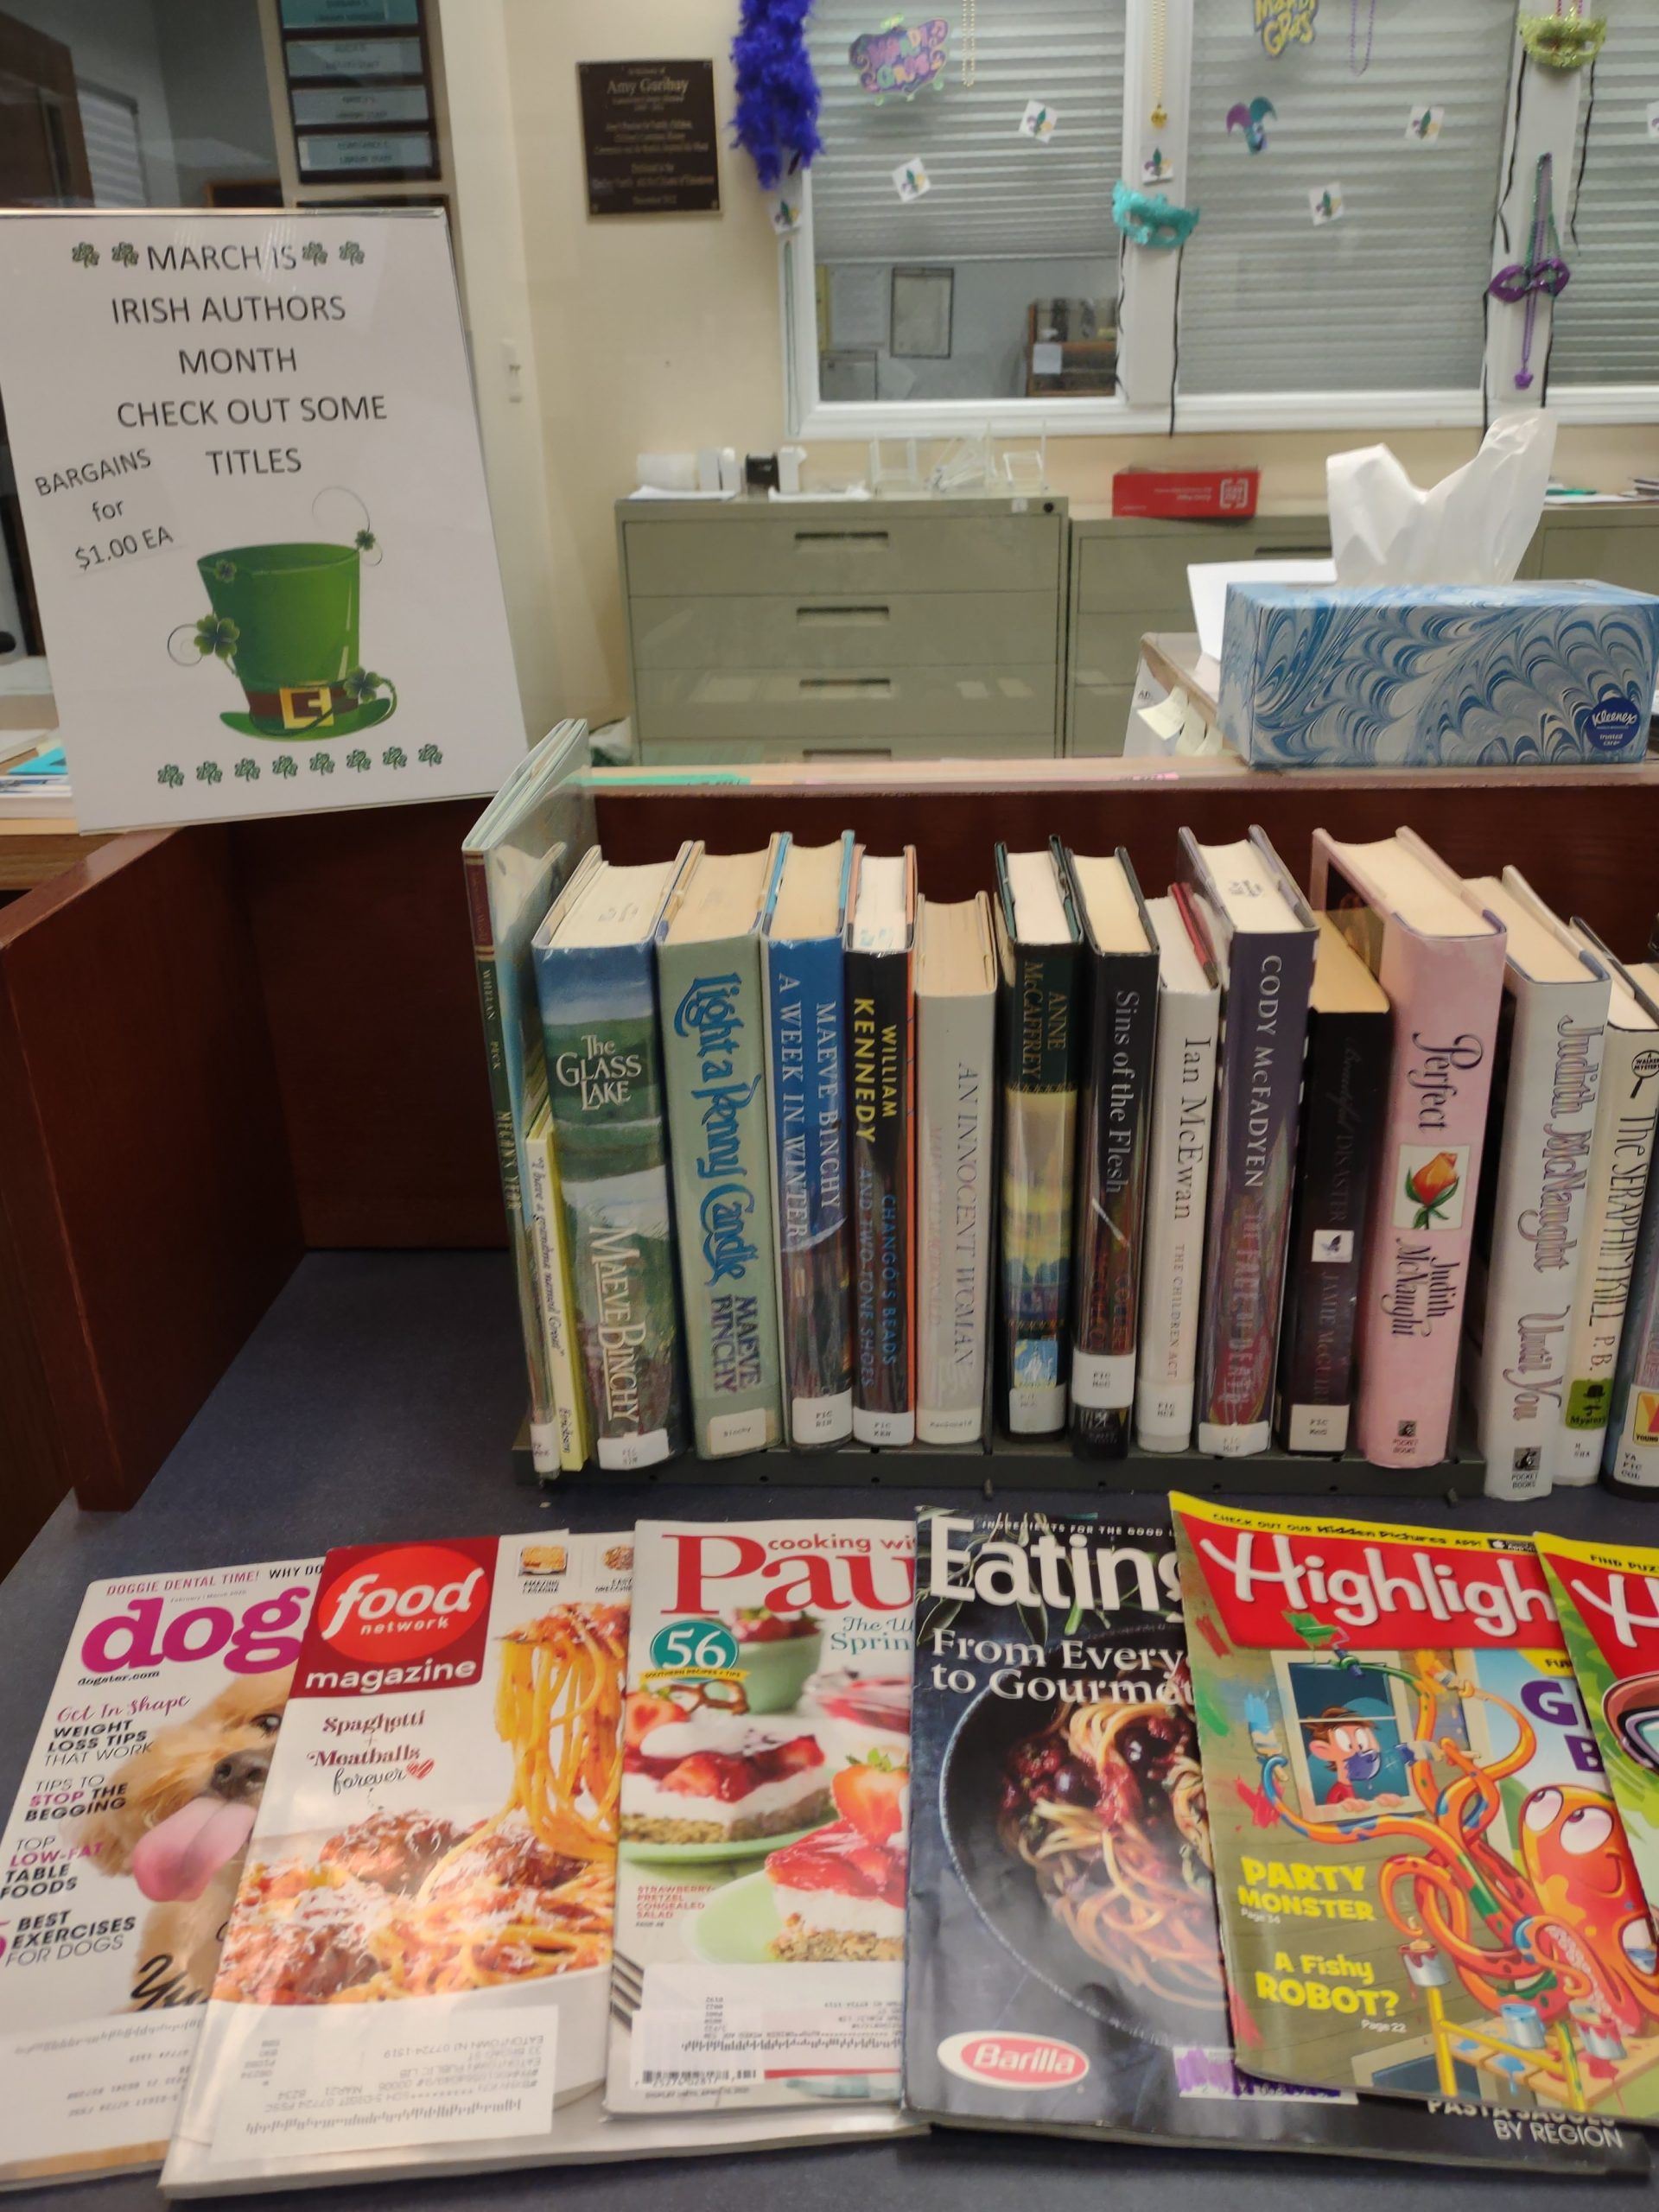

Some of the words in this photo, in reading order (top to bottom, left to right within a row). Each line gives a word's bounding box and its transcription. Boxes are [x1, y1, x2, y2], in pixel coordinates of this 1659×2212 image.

[147, 245, 262, 271] MARCH
[273, 245, 297, 270] IS
[111, 297, 190, 324] IRISH
[201, 296, 346, 323] AUTHORS
[178, 347, 297, 374] MONTH
[117, 400, 218, 428] CHECK
[226, 397, 290, 425] OUT
[300, 395, 388, 423] SOME
[35, 448, 151, 496] BARGAINS
[206, 448, 302, 475] TITLES
[92, 500, 124, 522] for
[74, 534, 137, 571] $1.00
[141, 525, 174, 550] EA
[1592, 709, 1637, 727] Kleenex
[779, 972, 801, 994] A
[1255, 955, 1282, 1035] CODY
[674, 972, 744, 1058] Light
[1022, 961, 1044, 1080] McCAFFREY
[1046, 991, 1068, 1051] ANNE
[1114, 990, 1139, 1046] Sins
[581, 1034, 616, 1057] The
[779, 1001, 804, 1083] WEEK
[816, 1000, 839, 1099] MAEVE
[556, 1052, 642, 1087] GLASS
[702, 1059, 733, 1082] a
[854, 998, 875, 1143] KENNEDY
[880, 1024, 897, 1117] WILLIAM
[1112, 1052, 1135, 1079] of
[1183, 1038, 1211, 1084] Ian
[1550, 1014, 1605, 1119] Judith
[581, 1079, 632, 1111] LAKE
[958, 1063, 978, 1106] AN
[1407, 1032, 1483, 1135] Perfect
[783, 1092, 804, 1123] IN
[1110, 1083, 1135, 1122] the
[691, 1073, 761, 1179] Penny
[1614, 1108, 1657, 1158] The
[818, 1109, 842, 1209] BINCHY
[1106, 1128, 1131, 1193] Flesh
[1175, 1095, 1207, 1220] McEwan
[783, 1133, 810, 1236] WINTER
[956, 1114, 977, 1252] INNOCENT
[1517, 1123, 1592, 1274] McNaught
[700, 1184, 759, 1287] Candle
[1174, 1244, 1185, 1271] THE
[589, 1226, 640, 1325] MAEVE
[1426, 1255, 1460, 1317] Judith
[954, 1266, 976, 1366] WOMAN
[1169, 1275, 1183, 1347] CHILDREN
[1588, 1277, 1630, 1327] KILL
[711, 1294, 737, 1394] BINCHY
[735, 1296, 760, 1386] MAEVE
[880, 1306, 897, 1366] BEADS
[1518, 1305, 1571, 1375] Until
[596, 1322, 647, 1423] BINCHY
[1167, 1351, 1178, 1377] ACT
[1503, 1368, 1563, 1421] You
[1070, 1524, 1093, 1535] FOR
[1098, 1526, 1122, 1535] THE
[1128, 1527, 1163, 1537] GOOD
[1213, 1513, 1252, 1527] CHECK
[1257, 1521, 1281, 1529] OUT
[768, 1533, 870, 1553] cooking
[1591, 1554, 1623, 1567] FIND
[106, 1583, 158, 1597] DOGGIE
[164, 1578, 216, 1592] DENTAL
[222, 1571, 259, 1584] TIME!
[270, 1567, 301, 1580] WHY
[321, 1567, 485, 1641] food
[360, 1615, 448, 1636] network
[842, 1616, 881, 1631] The
[663, 1628, 726, 1669] 56
[932, 1628, 1046, 1668] From
[1061, 1640, 1184, 1679] Every
[77, 1670, 160, 1686] dogster.com
[305, 1658, 477, 1694] magazine
[931, 1663, 976, 1693] to
[56, 1704, 95, 1724] Get
[100, 1700, 123, 1719] In
[130, 1694, 191, 1717] Shape
[322, 1709, 425, 1738] Spaghetti
[48, 1736, 99, 1753] LOSS
[105, 1731, 147, 1746] TIPS
[54, 1719, 133, 1738] WEIGHT
[44, 1751, 89, 1767] THAT
[96, 1741, 154, 1760] WORK
[306, 1744, 421, 1767] Meatballs
[29, 1790, 85, 1808] STOP
[91, 1783, 128, 1800] THE
[35, 1778, 73, 1792] TIPS
[80, 1774, 105, 1788] TO
[333, 1764, 408, 1796] forever
[24, 1797, 126, 1822] BEGGING
[9, 1841, 105, 1867] LOW-FAT
[16, 1835, 56, 1852] TOP
[0, 1876, 78, 1900] FOODS
[5, 1864, 70, 1883] TABLE
[1241, 1857, 1366, 1892] PARTY
[1237, 1885, 1376, 1922] MONSTER
[1241, 1907, 1263, 1923] Page
[11, 1916, 136, 1949] EXERCISES
[16, 1910, 72, 1932] BEST
[4, 1947, 50, 1967] FOR
[56, 1934, 124, 1961] DOGS
[1274, 1951, 1294, 1973] A
[1300, 1954, 1375, 1986] Fishy
[1255, 1971, 1400, 2017] ROBOT?
[1361, 2018, 1389, 2033] Page
[973, 2043, 1076, 2075] Barilla
[1494, 2120, 1522, 2140] BY
[1530, 2121, 1624, 2149] REGION
